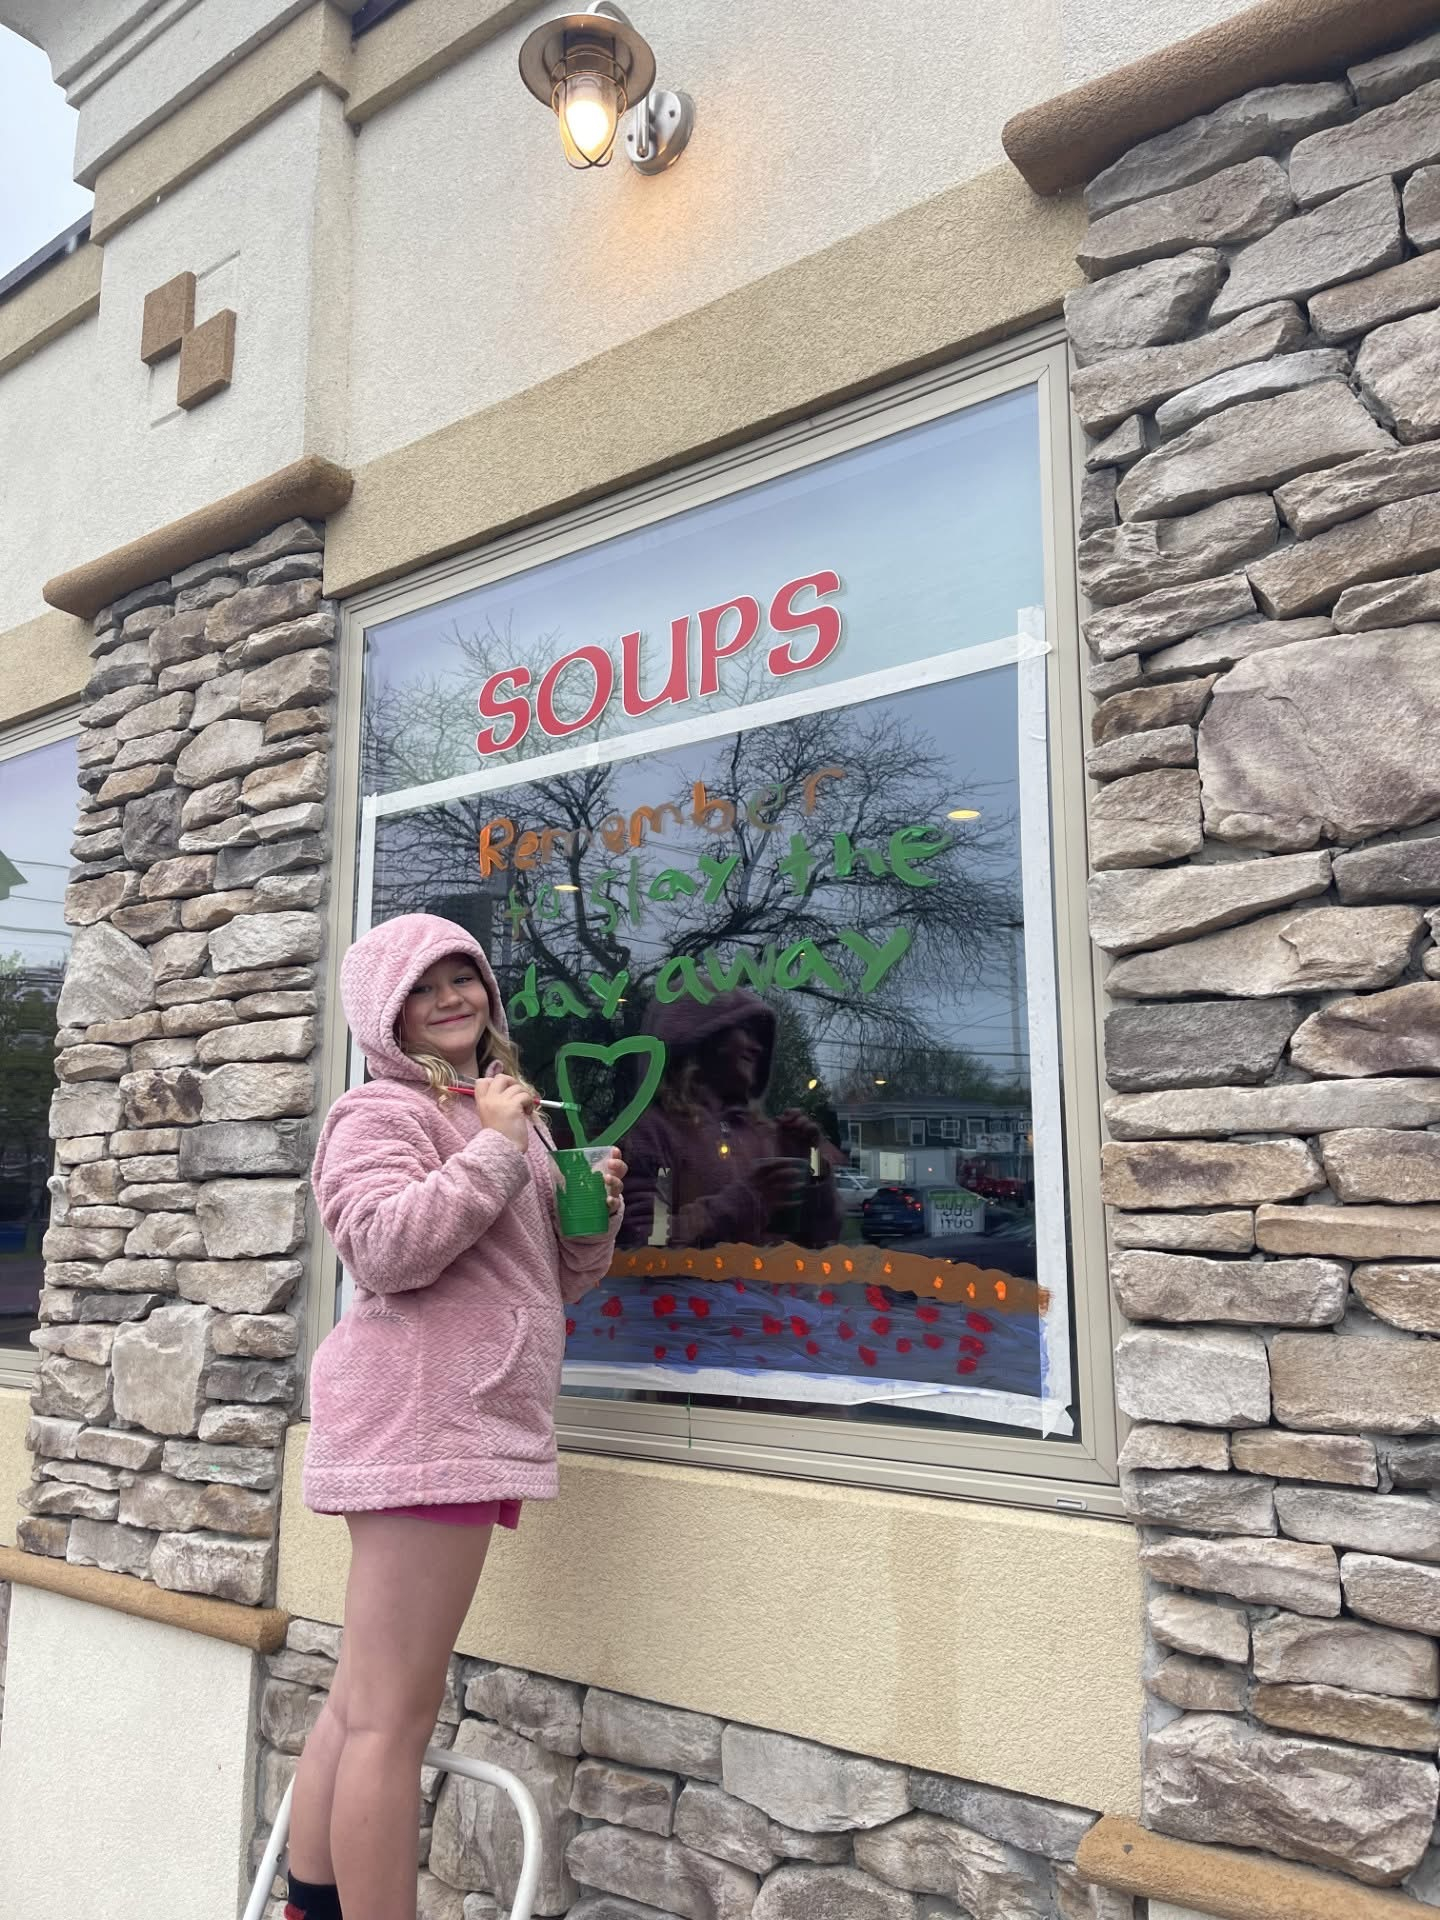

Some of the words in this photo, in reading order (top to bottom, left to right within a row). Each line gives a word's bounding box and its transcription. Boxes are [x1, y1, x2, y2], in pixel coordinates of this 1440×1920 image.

[476, 568, 842, 756] SOUPS
[479, 767, 847, 879] Remember
[503, 883, 561, 941] to
[590, 854, 741, 935] slay
[778, 824, 952, 897] the
[507, 963, 629, 1026] day
[654, 926, 912, 1006] away
